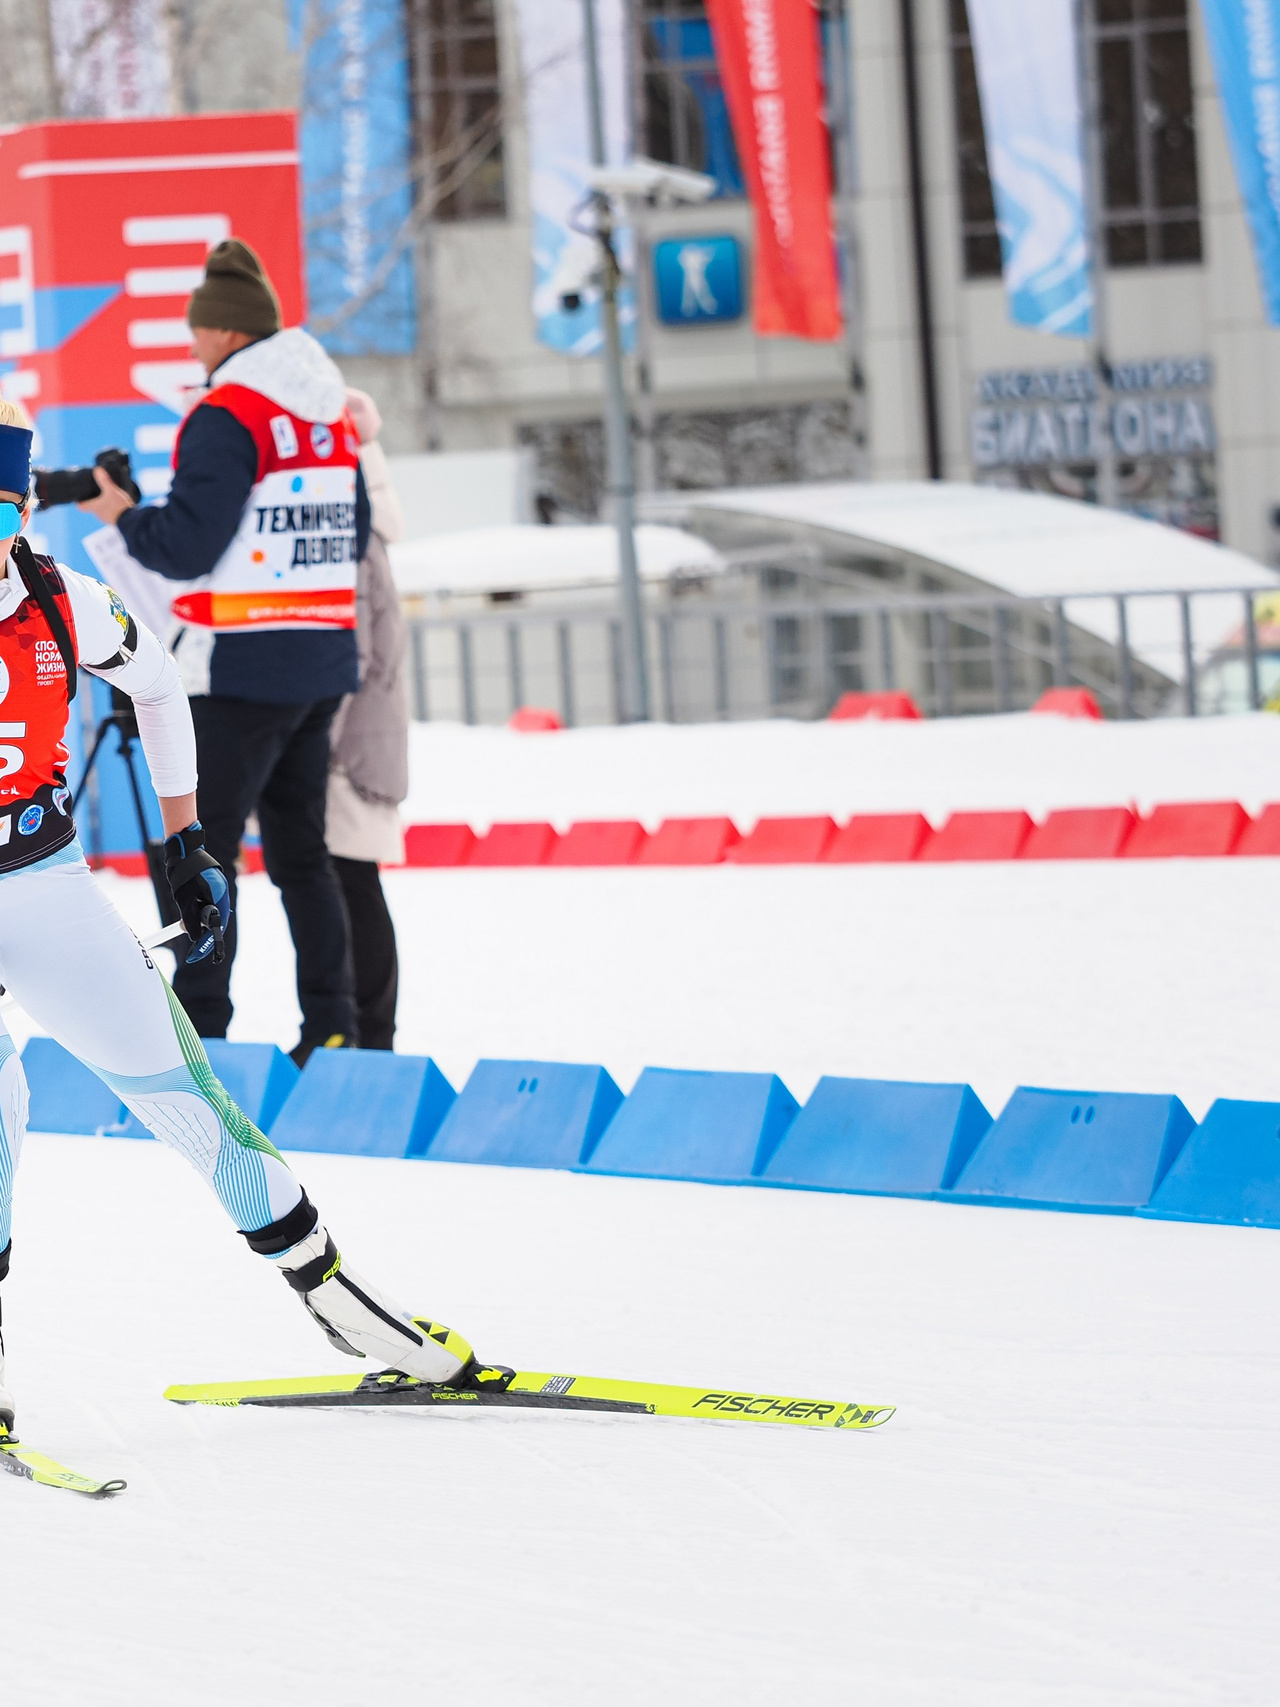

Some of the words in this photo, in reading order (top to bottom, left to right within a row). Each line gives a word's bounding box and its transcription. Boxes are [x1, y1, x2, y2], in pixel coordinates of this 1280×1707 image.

[972, 400, 1216, 464] БИАТОНА
[431, 1392, 479, 1401] FISCHER
[691, 1393, 835, 1421] FISCHER
